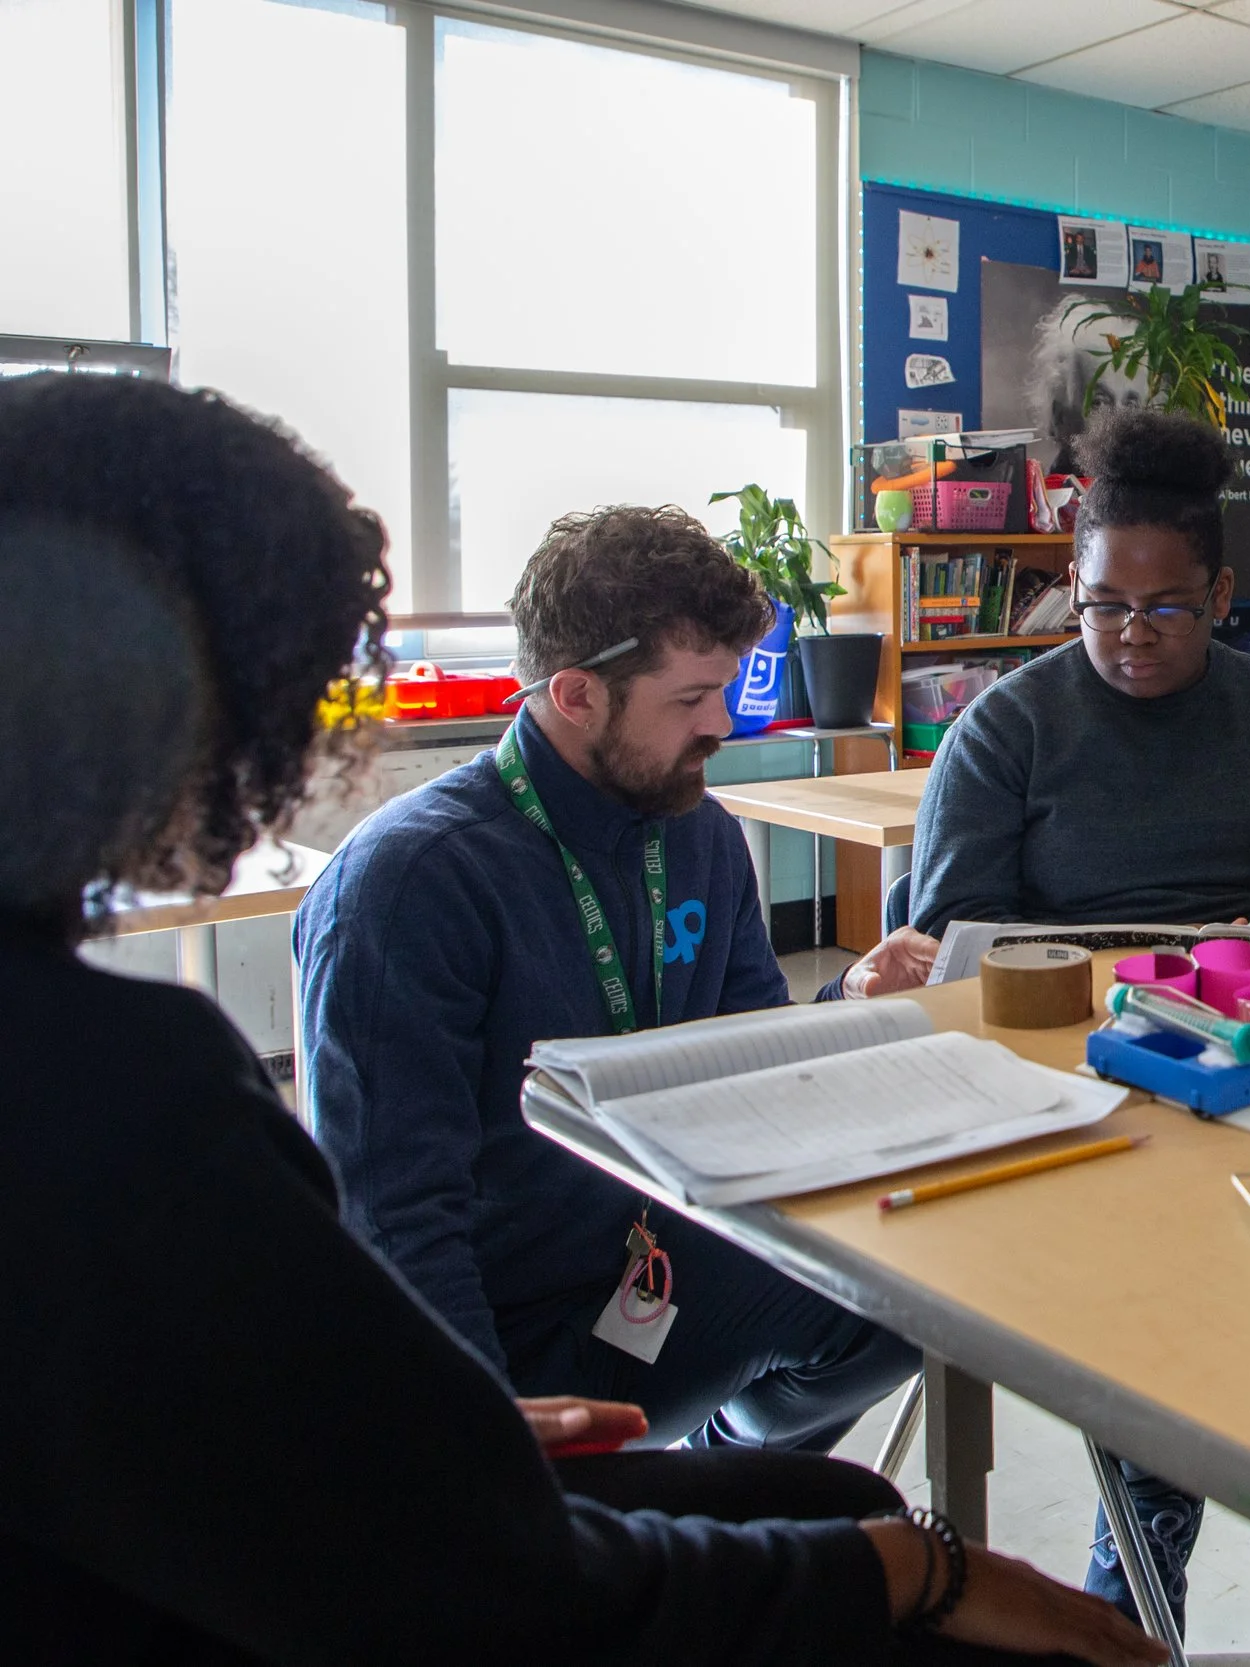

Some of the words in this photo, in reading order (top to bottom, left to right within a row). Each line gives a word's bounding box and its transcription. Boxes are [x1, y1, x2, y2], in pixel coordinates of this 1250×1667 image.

[644, 840, 663, 874] CELTICS
[580, 894, 603, 935] CELTICS
[602, 977, 628, 1014] CELTICS
